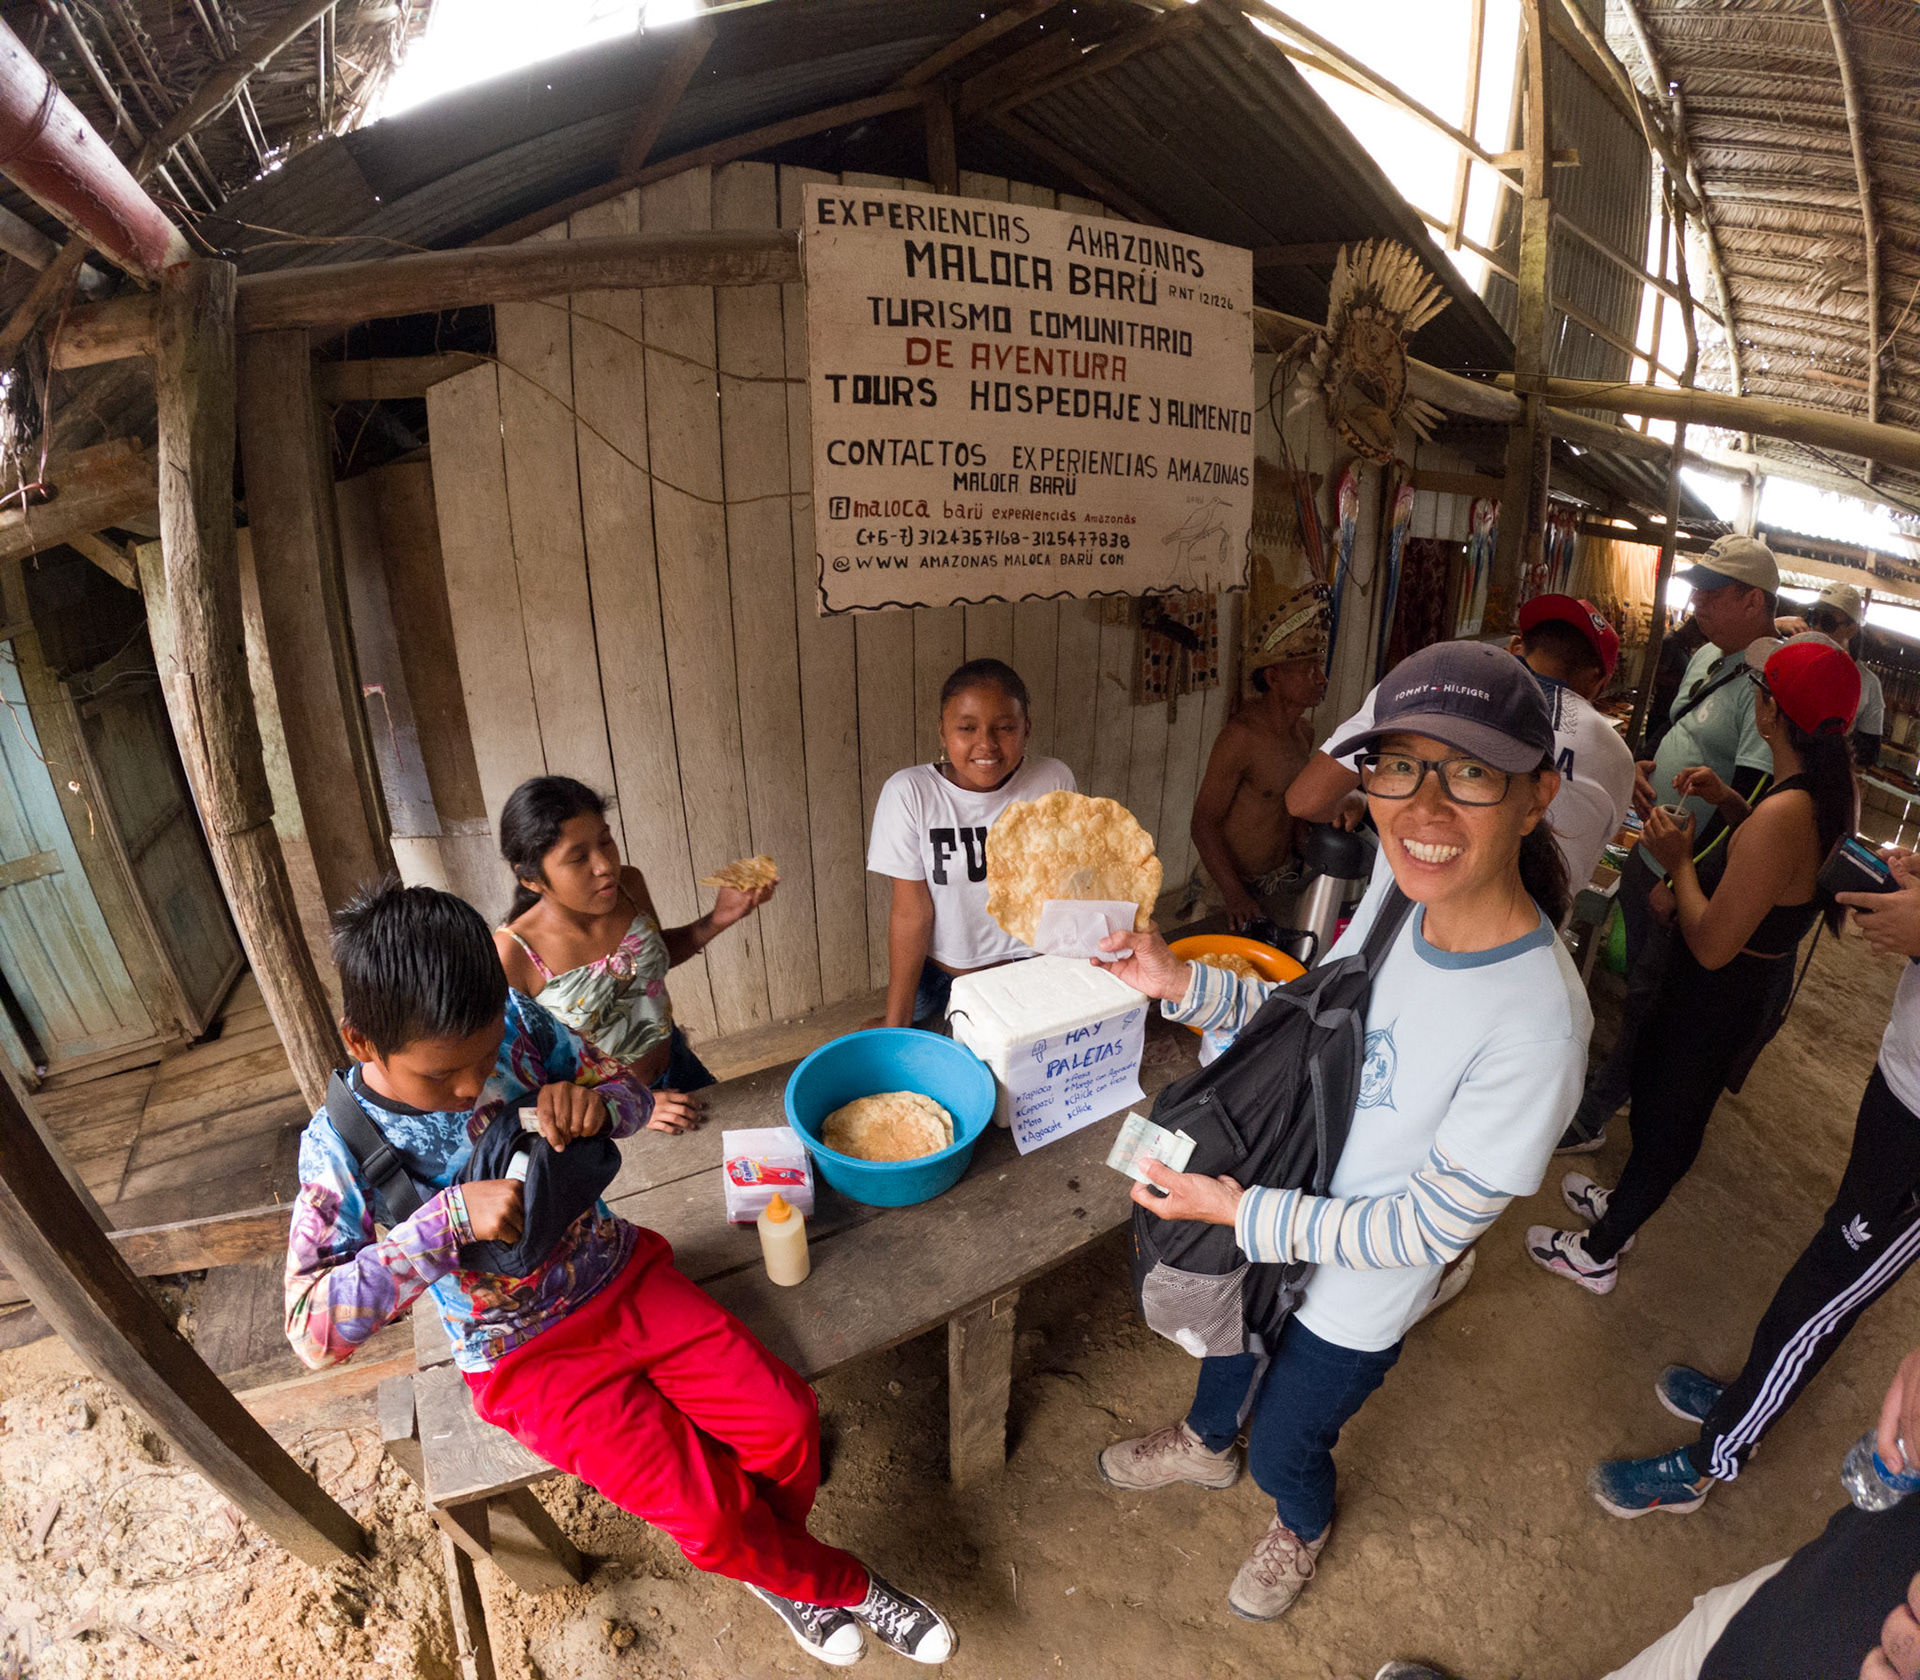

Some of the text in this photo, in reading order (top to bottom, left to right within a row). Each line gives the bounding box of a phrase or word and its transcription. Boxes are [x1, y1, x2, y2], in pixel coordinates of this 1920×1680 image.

[817, 198, 1205, 278] EXPERIENCIAS AMAZONAS
[904, 240, 1157, 306] MALOCA BARÜ
[1169, 284, 1234, 310] RNT 121226
[867, 296, 1193, 357] TURISMO COMUNITARIO
[906, 337, 1127, 382] DE AVENTURA
[825, 374, 937, 408] TOURS
[970, 381, 1140, 422] HOSPEDAJE
[1168, 399, 1251, 435] ALIMENTO
[827, 439, 1250, 486] CONTACTOS EXPERIENCIAS AMAZONAS
[953, 473, 1076, 496] MALOCA BARÜ
[943, 500, 983, 520] barü
[856, 525, 913, 547] (+5-7)
[920, 555, 998, 568] AMAZONAS
[1004, 553, 1051, 567] MALOCA
[1060, 549, 1093, 566] BARÜ
[1100, 553, 1124, 566] COM
[1395, 684, 1490, 702] TOMMY HILFIGER
[1065, 1021, 1103, 1046] HAY
[1046, 1038, 1123, 1079] PALETAS
